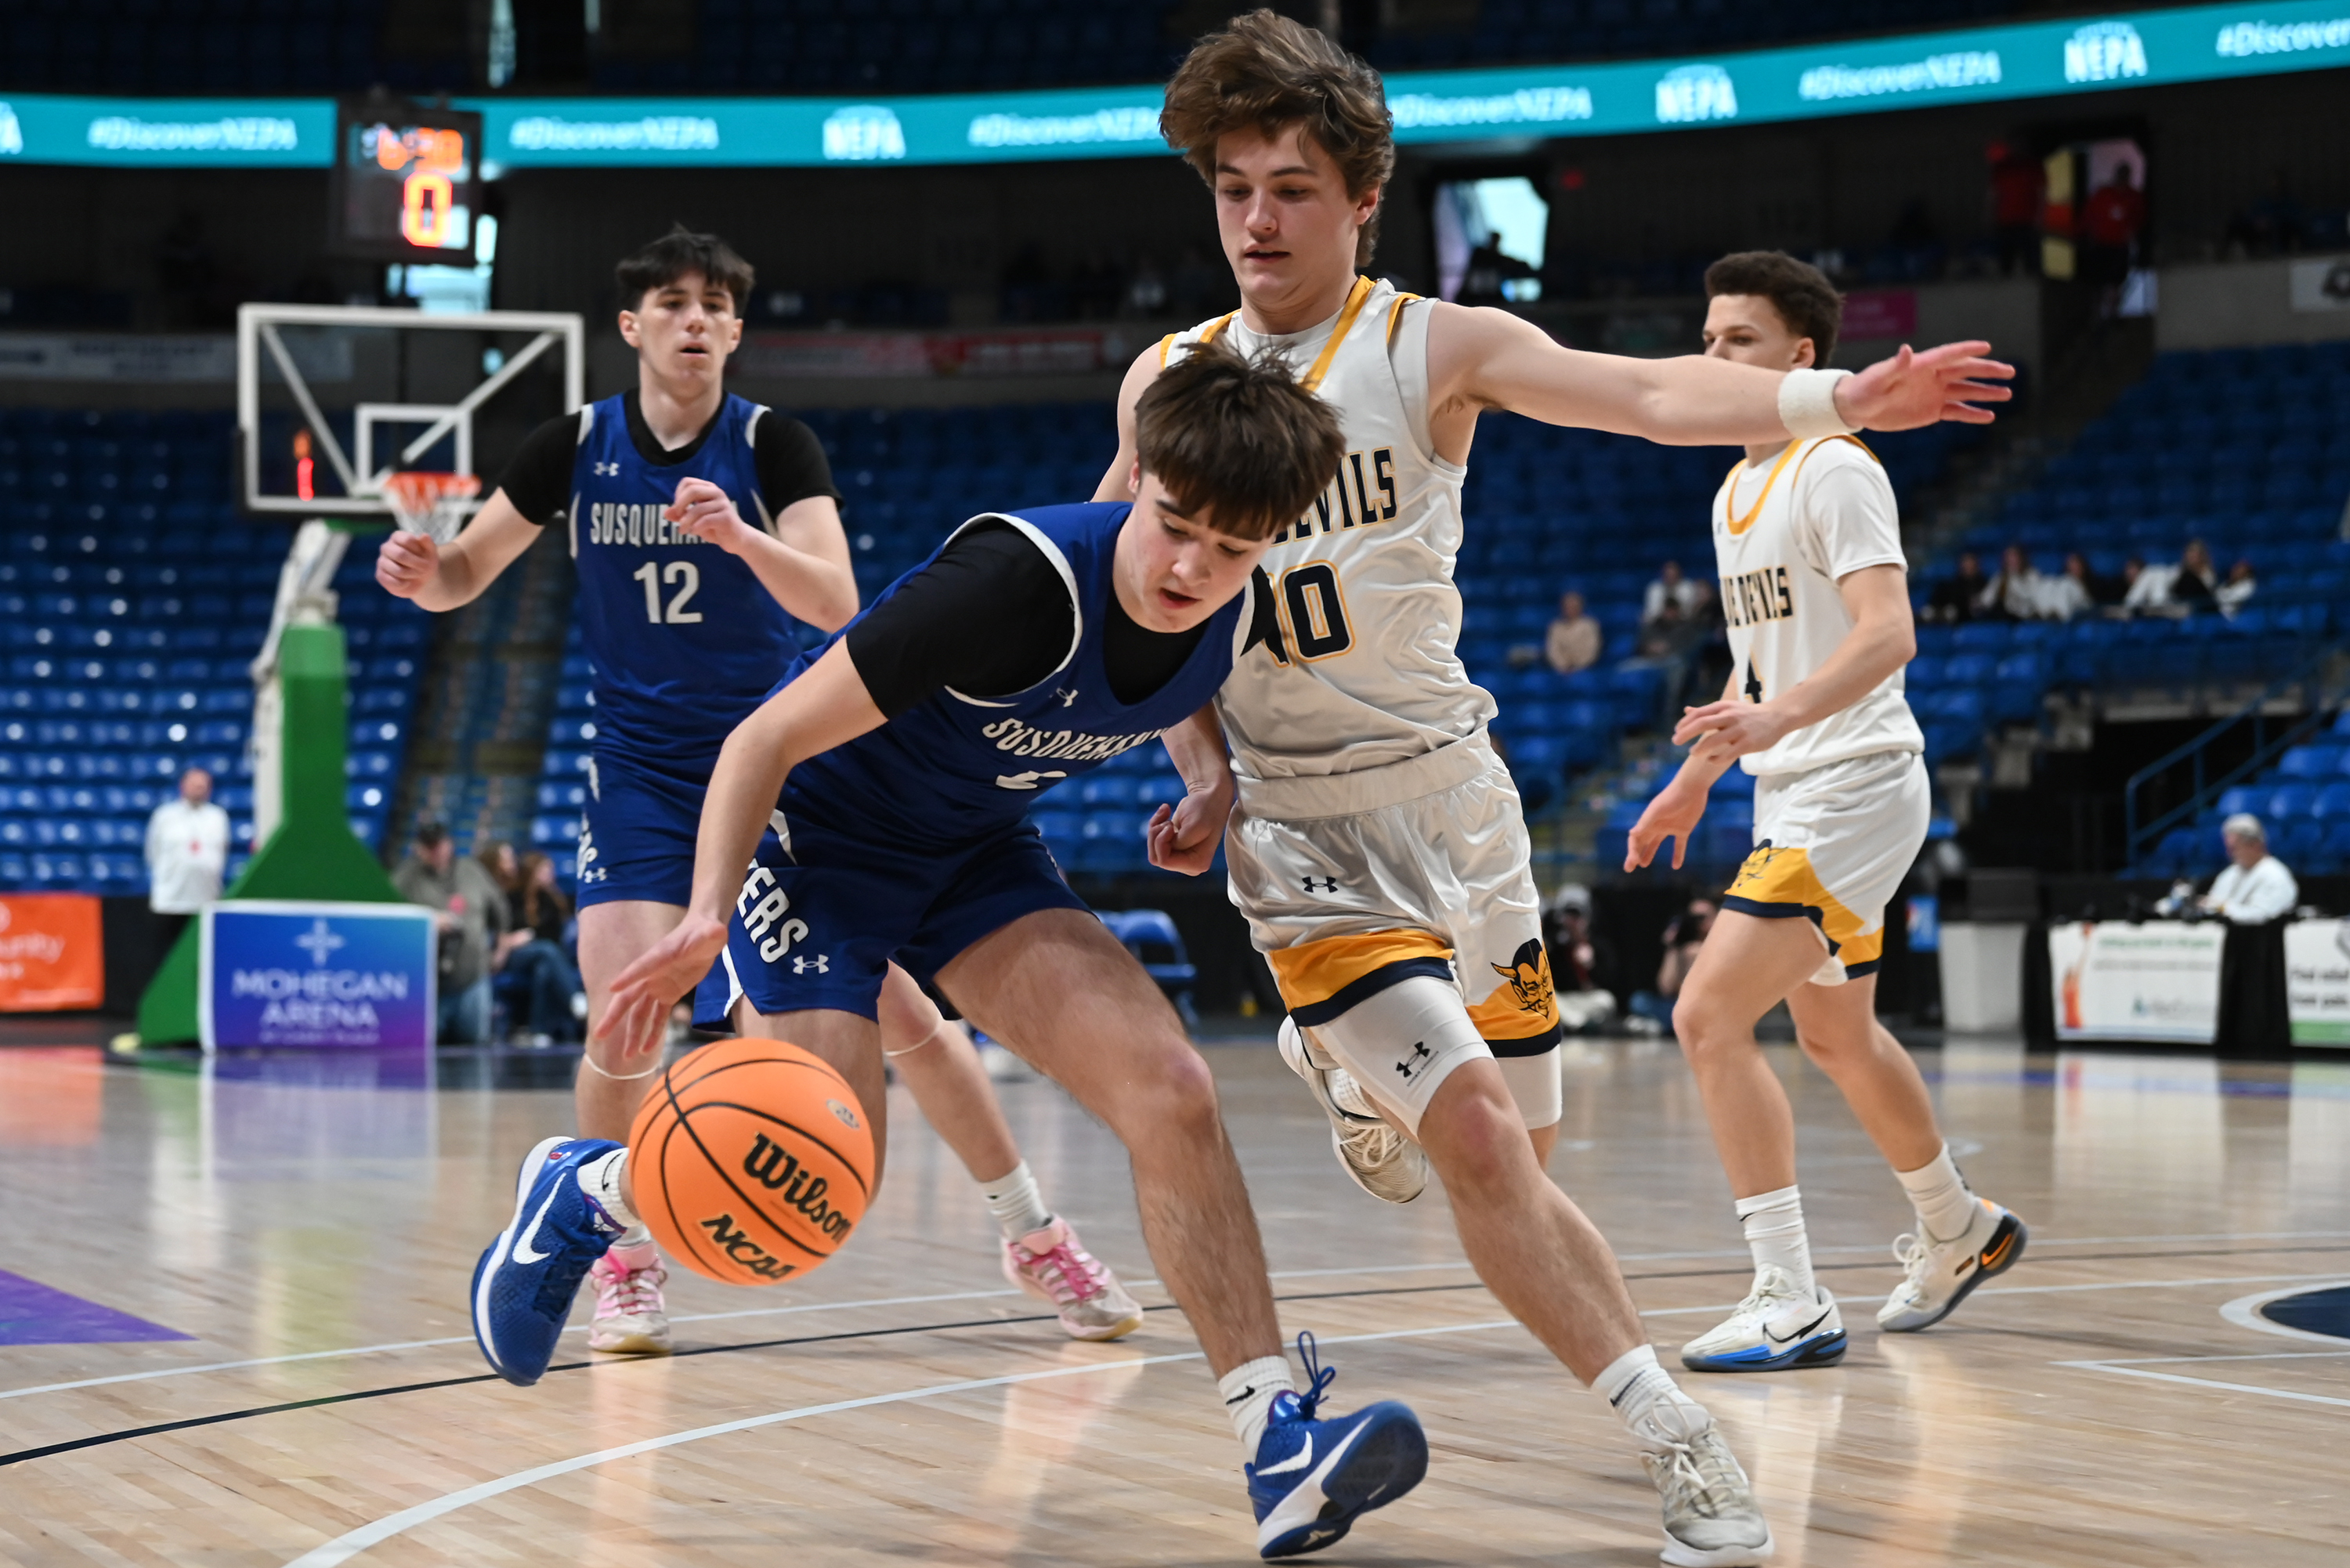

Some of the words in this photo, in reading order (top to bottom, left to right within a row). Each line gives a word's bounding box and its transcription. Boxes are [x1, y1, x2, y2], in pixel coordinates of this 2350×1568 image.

[2064, 36, 2148, 84] NEPA
[1655, 77, 1737, 123] NEPA
[87, 116, 298, 150] #DiscoverNEPA
[822, 115, 906, 160] NEPA
[633, 561, 703, 624] 12
[230, 968, 408, 1001] MOHEGAN
[258, 998, 380, 1030] ARENA
[743, 1131, 851, 1245] Wilson
[701, 1213, 797, 1280] NCAA
